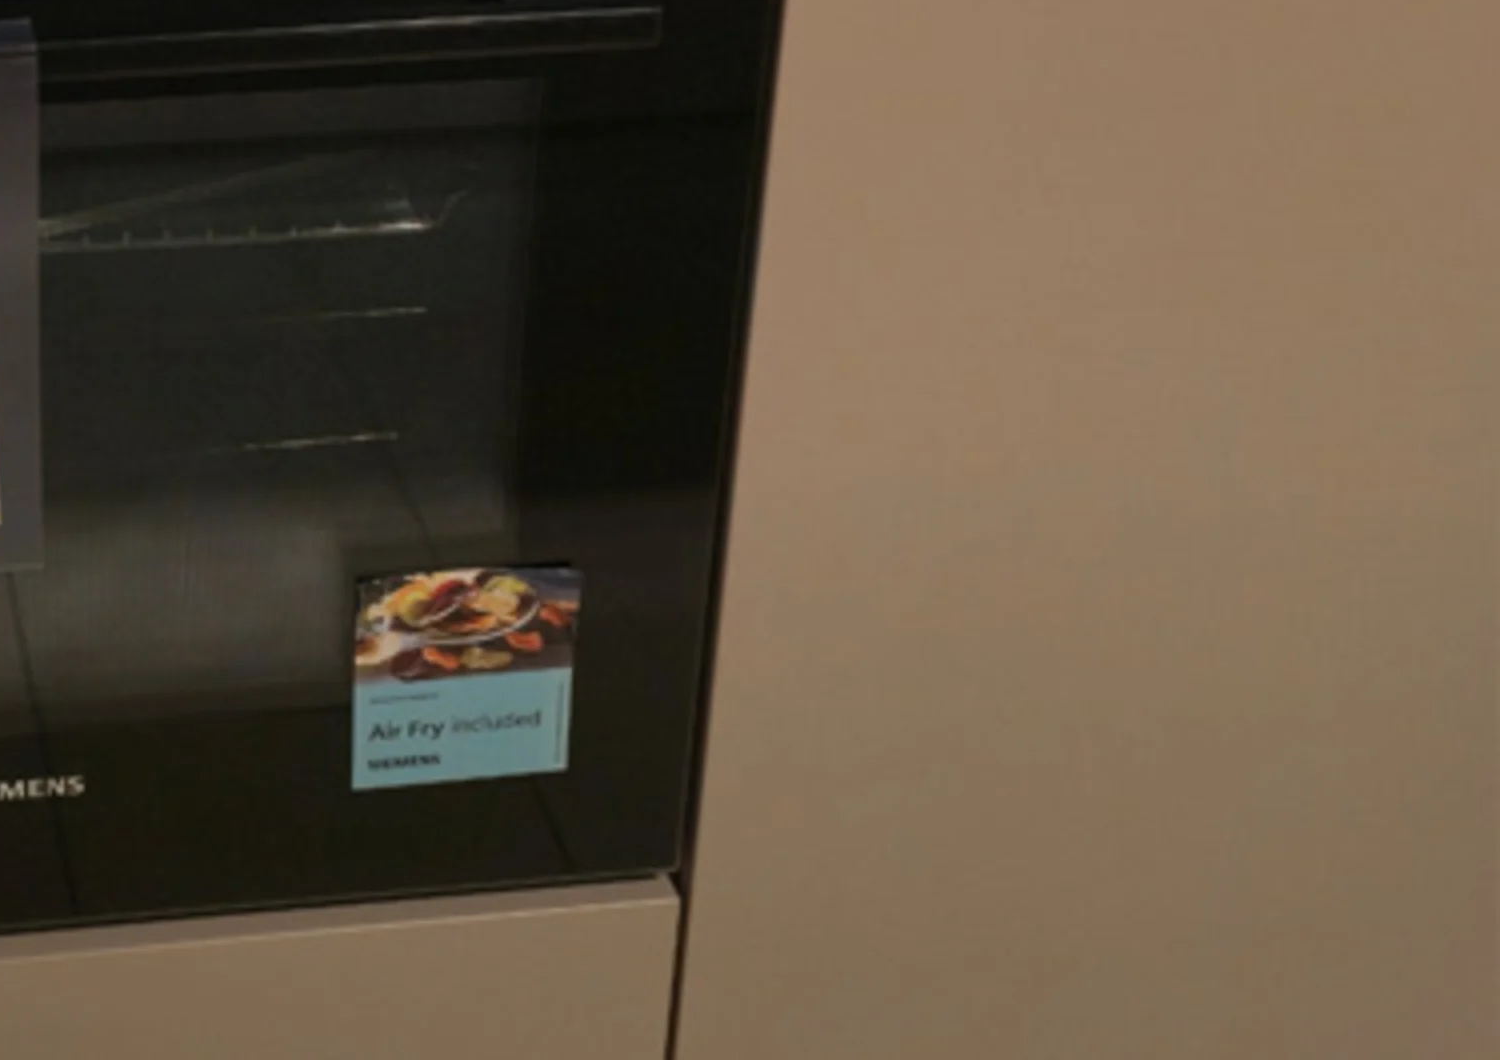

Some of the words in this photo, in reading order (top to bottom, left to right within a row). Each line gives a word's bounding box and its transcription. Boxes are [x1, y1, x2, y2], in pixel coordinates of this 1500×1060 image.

[367, 722, 403, 742] Air
[407, 718, 445, 741] Fry
[451, 710, 542, 734] included
[366, 753, 441, 772] SIEMENS
